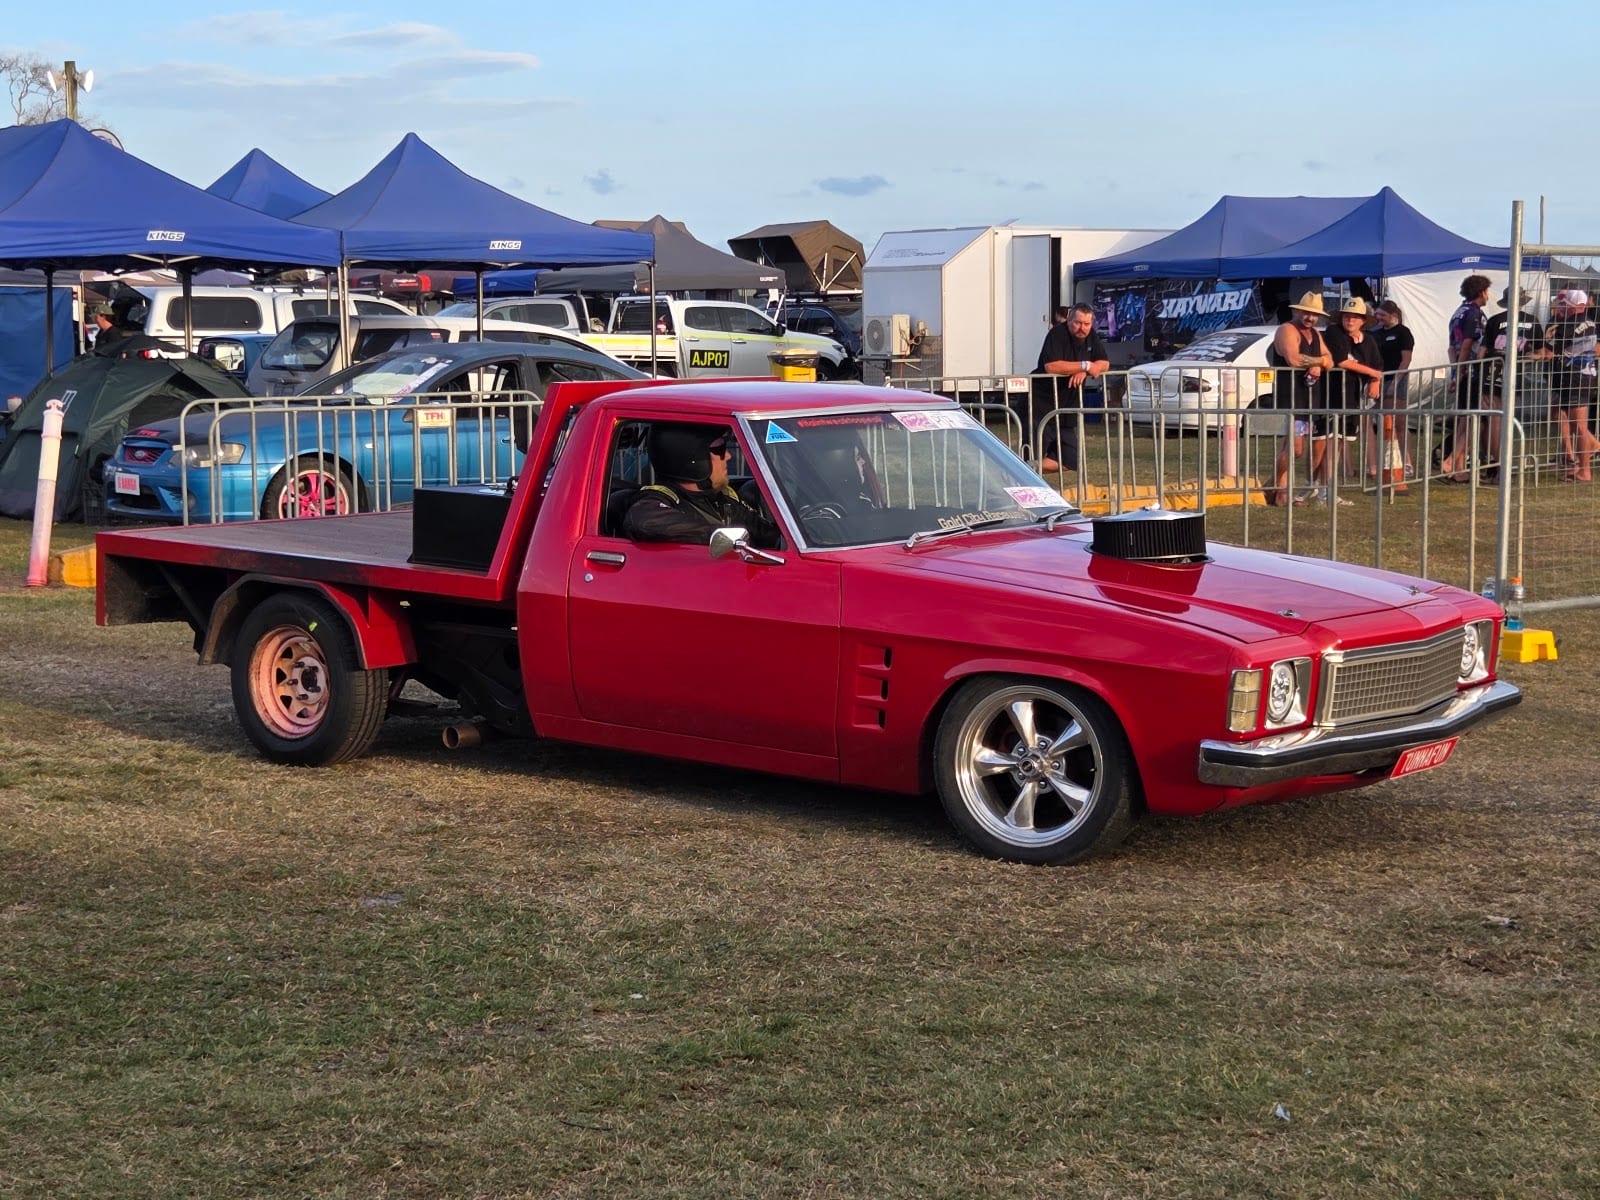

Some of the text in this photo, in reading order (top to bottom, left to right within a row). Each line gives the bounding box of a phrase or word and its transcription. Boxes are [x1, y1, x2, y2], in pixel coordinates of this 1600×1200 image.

[148, 231, 185, 241] KINGS
[490, 241, 521, 249] KINGS
[1157, 288, 1252, 318] HAYWARD
[692, 351, 728, 366] AJP01
[424, 411, 444, 420] TFH
[938, 516, 962, 529] Gold
[962, 513, 985, 525] City
